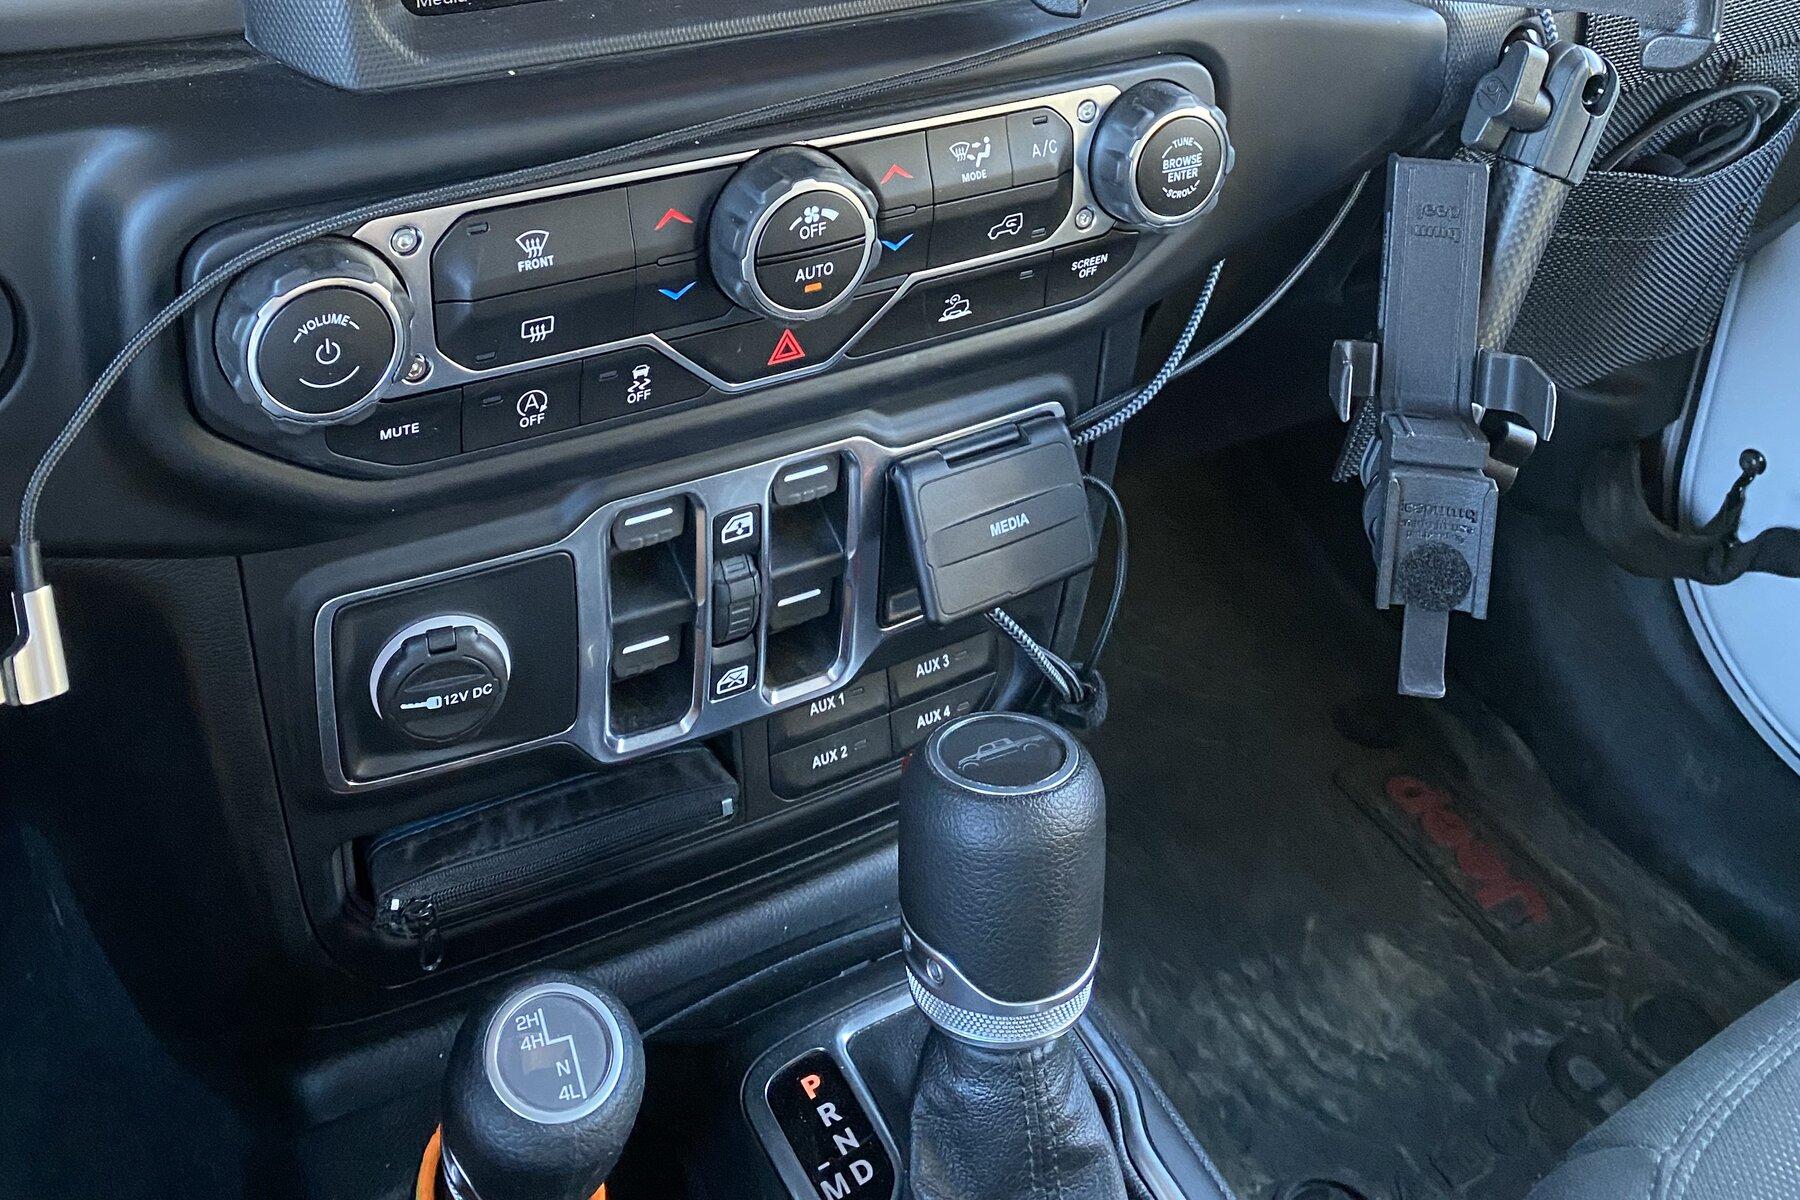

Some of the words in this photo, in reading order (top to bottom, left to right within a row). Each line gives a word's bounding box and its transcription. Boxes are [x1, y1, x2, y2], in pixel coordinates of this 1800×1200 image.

[1032, 139, 1058, 158] A/C
[1172, 137, 1194, 148] TUNE
[1163, 153, 1202, 170] BROWSE
[961, 169, 987, 183] MODE
[1168, 168, 1198, 183] ENTER
[1166, 185, 1197, 199] SCROLL
[799, 221, 827, 240] OFF
[517, 254, 554, 273] FRONT
[1071, 253, 1109, 271] SCREEN
[794, 262, 834, 283] AUTO
[1078, 265, 1098, 279] OFF
[299, 313, 350, 335] VOLUME
[626, 388, 652, 404] OFF
[519, 413, 546, 429] OFF
[379, 421, 420, 441] MUTE
[989, 512, 1030, 537] MEDIA
[915, 657, 940, 678] AUX
[443, 690, 471, 706] 12V
[472, 684, 493, 700] DC
[809, 694, 836, 717] AUX
[916, 708, 941, 730] AUX
[812, 748, 838, 770] AUX
[515, 1012, 540, 1031] 2H
[520, 1032, 545, 1051] 4H
[556, 1059, 571, 1077] N
[559, 1084, 581, 1100] 4L
[800, 1074, 821, 1100] P
[816, 1102, 843, 1128] R
[832, 1127, 860, 1156] N
[820, 1172, 851, 1200] M
[849, 1159, 874, 1186] D
